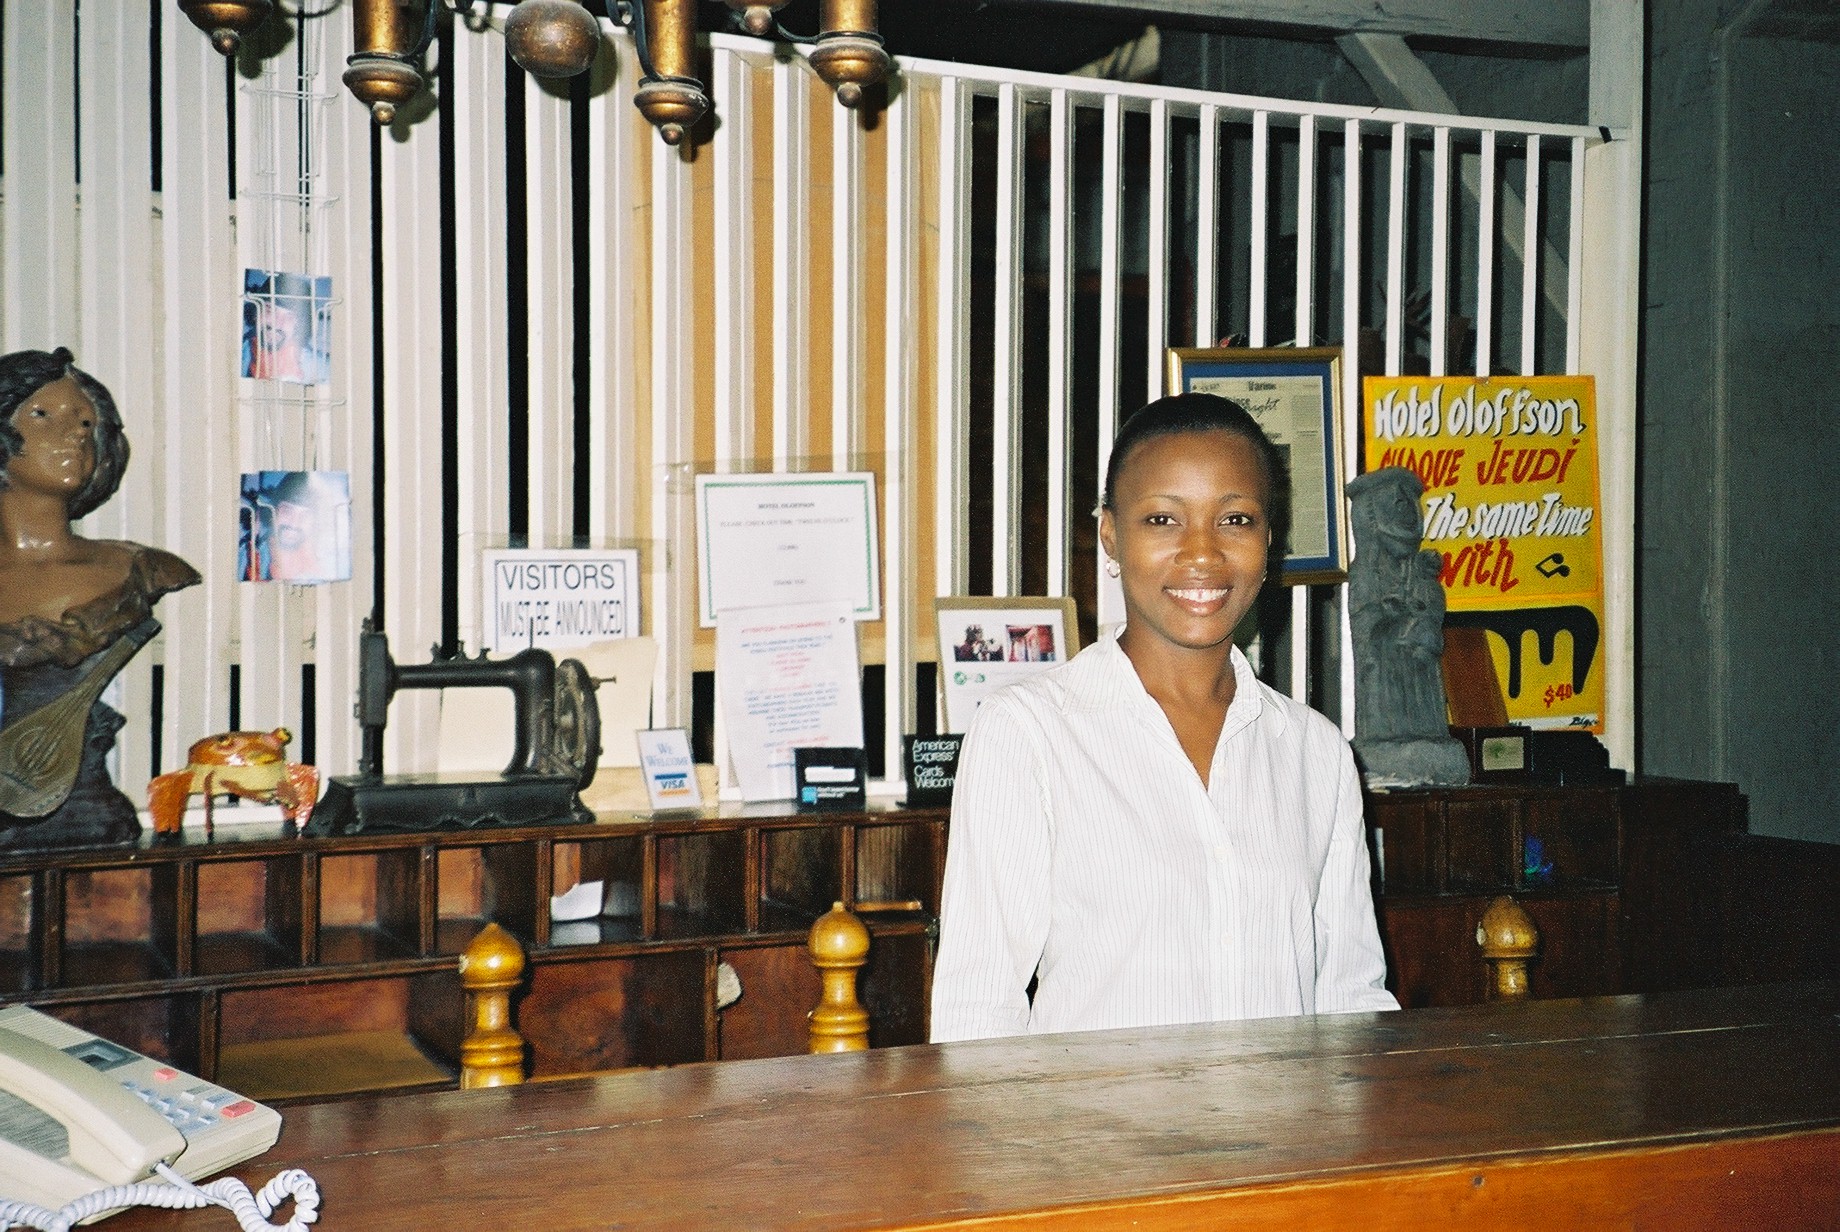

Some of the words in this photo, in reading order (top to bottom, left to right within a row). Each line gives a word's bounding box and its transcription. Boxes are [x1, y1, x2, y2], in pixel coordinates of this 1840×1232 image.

[1373, 384, 1444, 442] Hotel
[1422, 493, 1470, 541] The
[1536, 492, 1593, 537] Time
[502, 563, 616, 591] VISITORS
[536, 600, 550, 637] BE
[555, 599, 623, 636] ANNOUNCED
[912, 739, 959, 752] American
[913, 750, 956, 763] Express
[914, 765, 944, 778] Cards
[661, 779, 686, 790] VISA
[914, 775, 956, 788] Welcom
